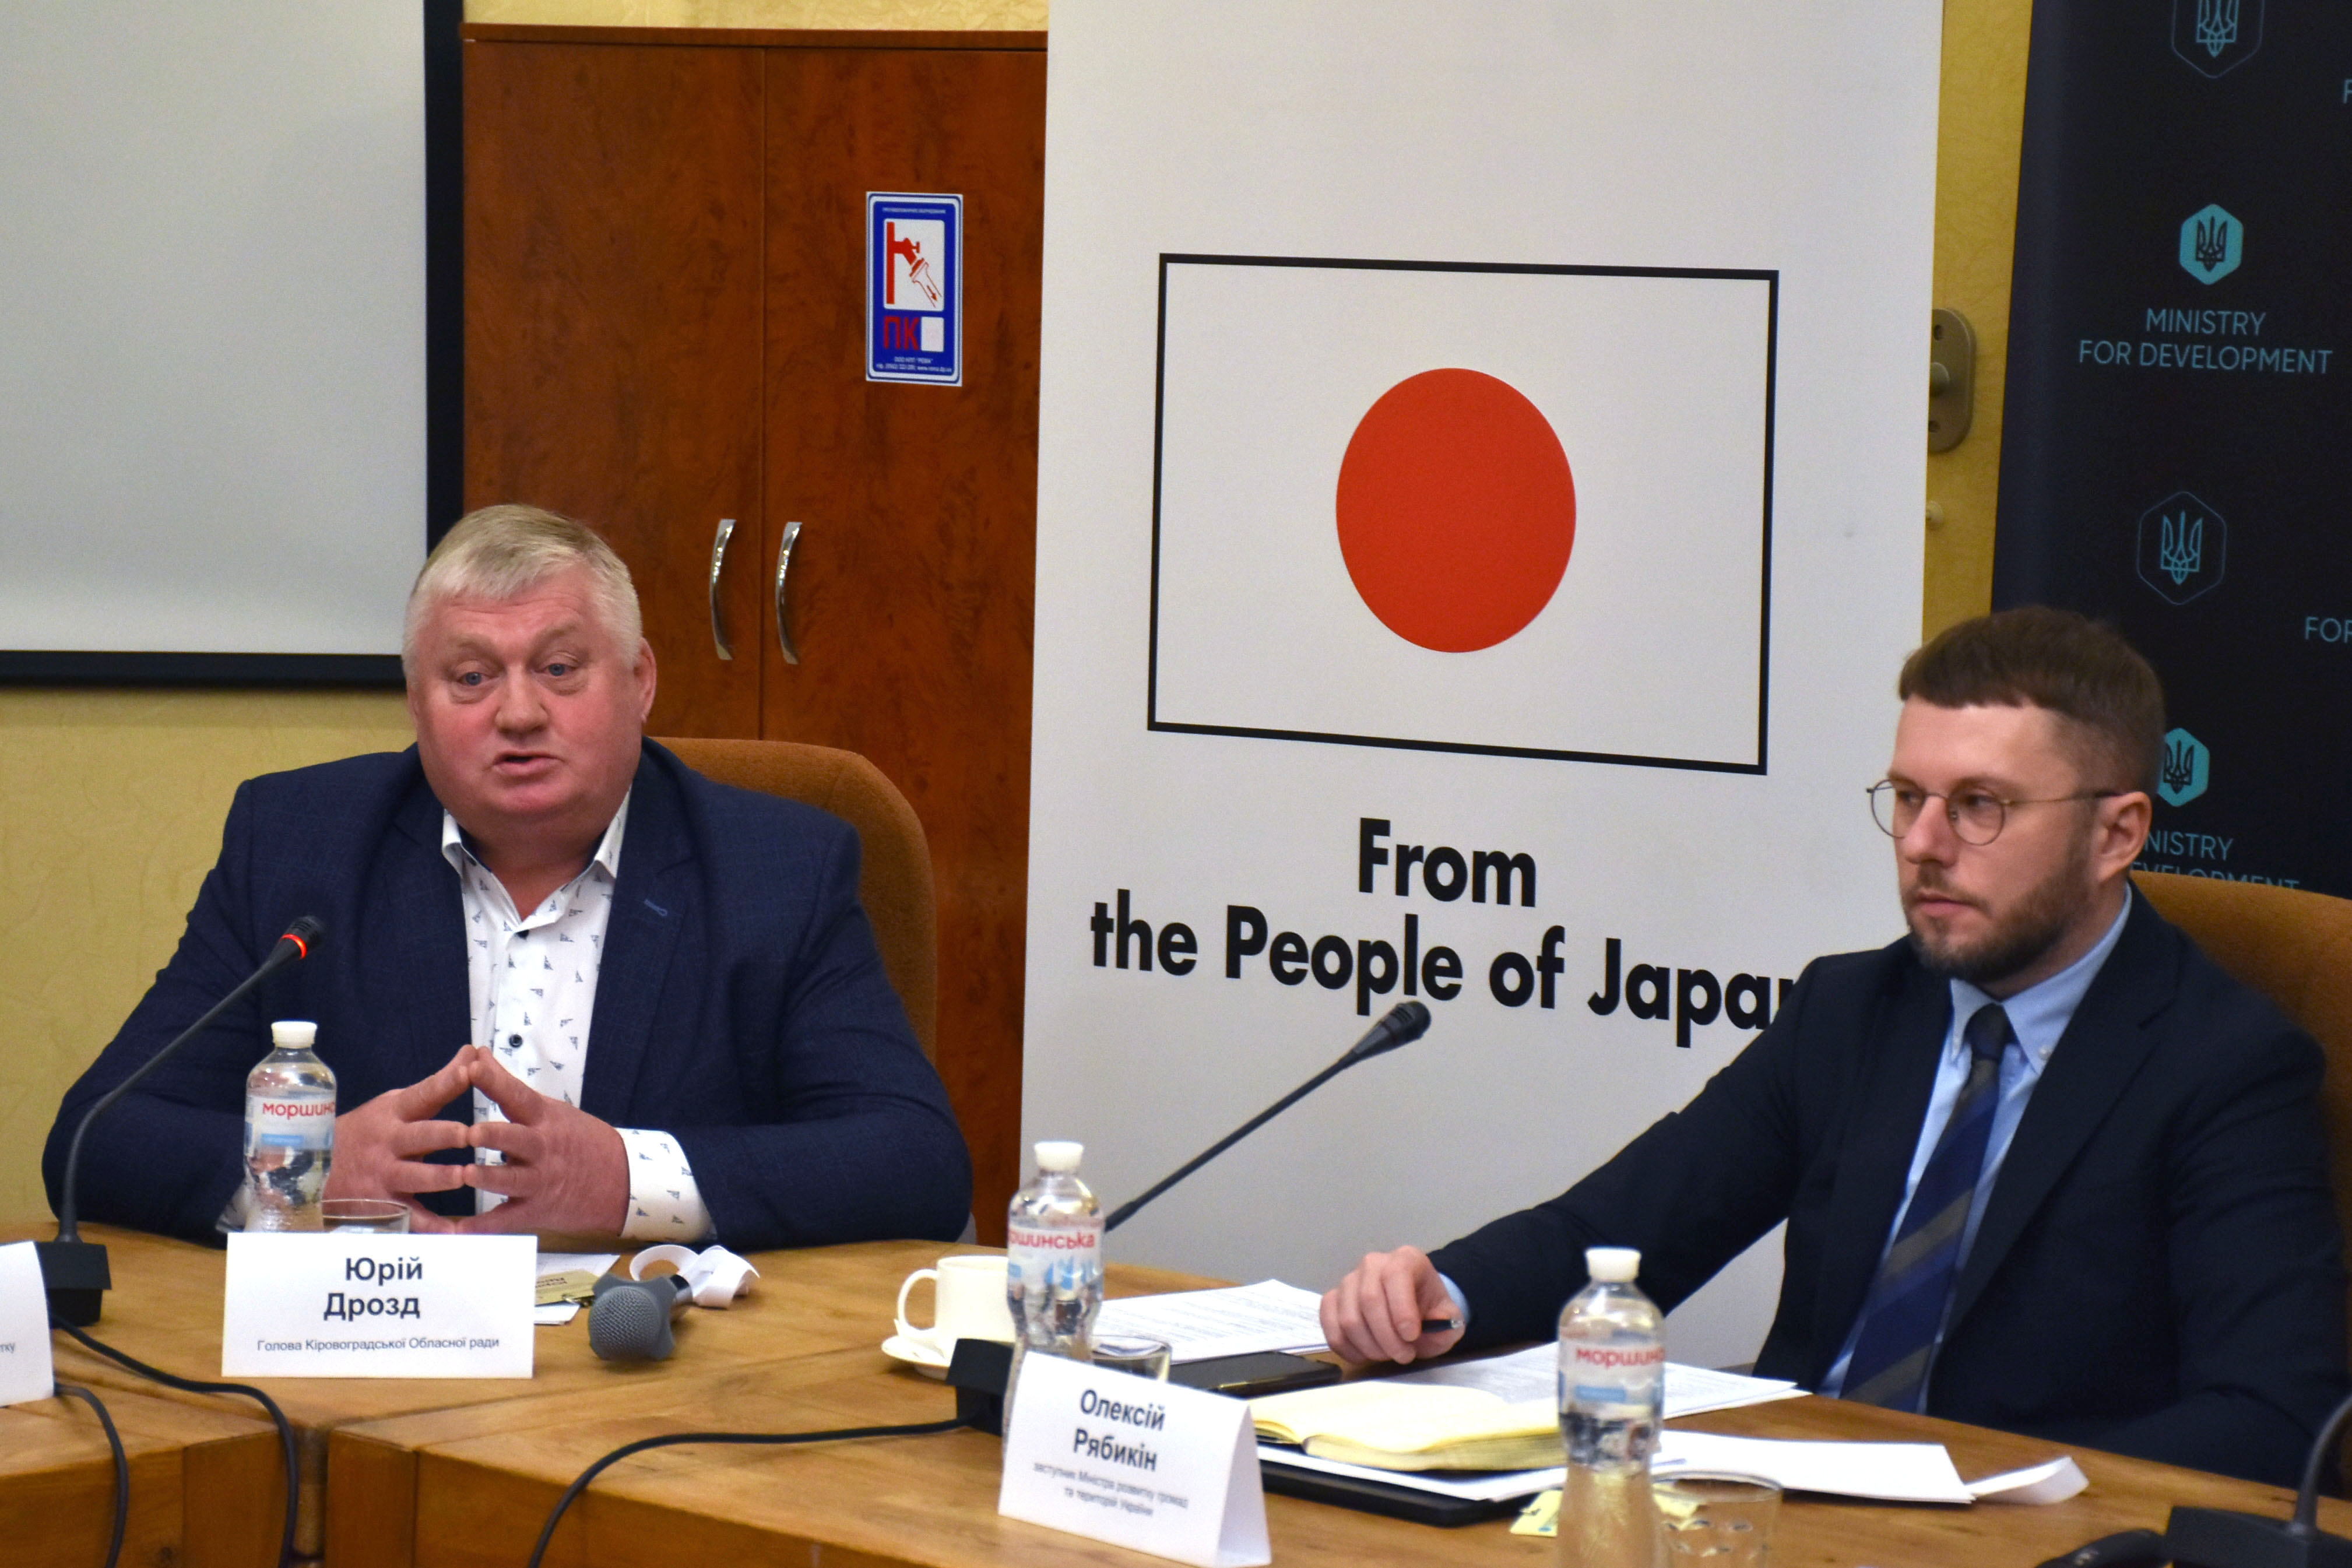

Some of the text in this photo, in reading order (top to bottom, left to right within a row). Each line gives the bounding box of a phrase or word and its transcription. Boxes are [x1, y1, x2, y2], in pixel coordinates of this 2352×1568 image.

[883, 316, 919, 350] ПК
[2146, 308, 2266, 336] MINISTRY
[2079, 339, 2332, 374] FOR DEVELOPMENT
[1359, 817, 1537, 907] From
[2143, 829, 2234, 862] NISTRY
[1090, 888, 1198, 976] the
[1225, 903, 1464, 1015] People
[1489, 925, 1565, 1010] of
[345, 1256, 423, 1286] Юрій
[323, 1292, 421, 1322] Дрозд
[257, 1337, 500, 1353] Голова Кіровоградської Обласної ради
[1080, 1389, 1166, 1432] Олексій
[1073, 1429, 1158, 1472] Рябикін
